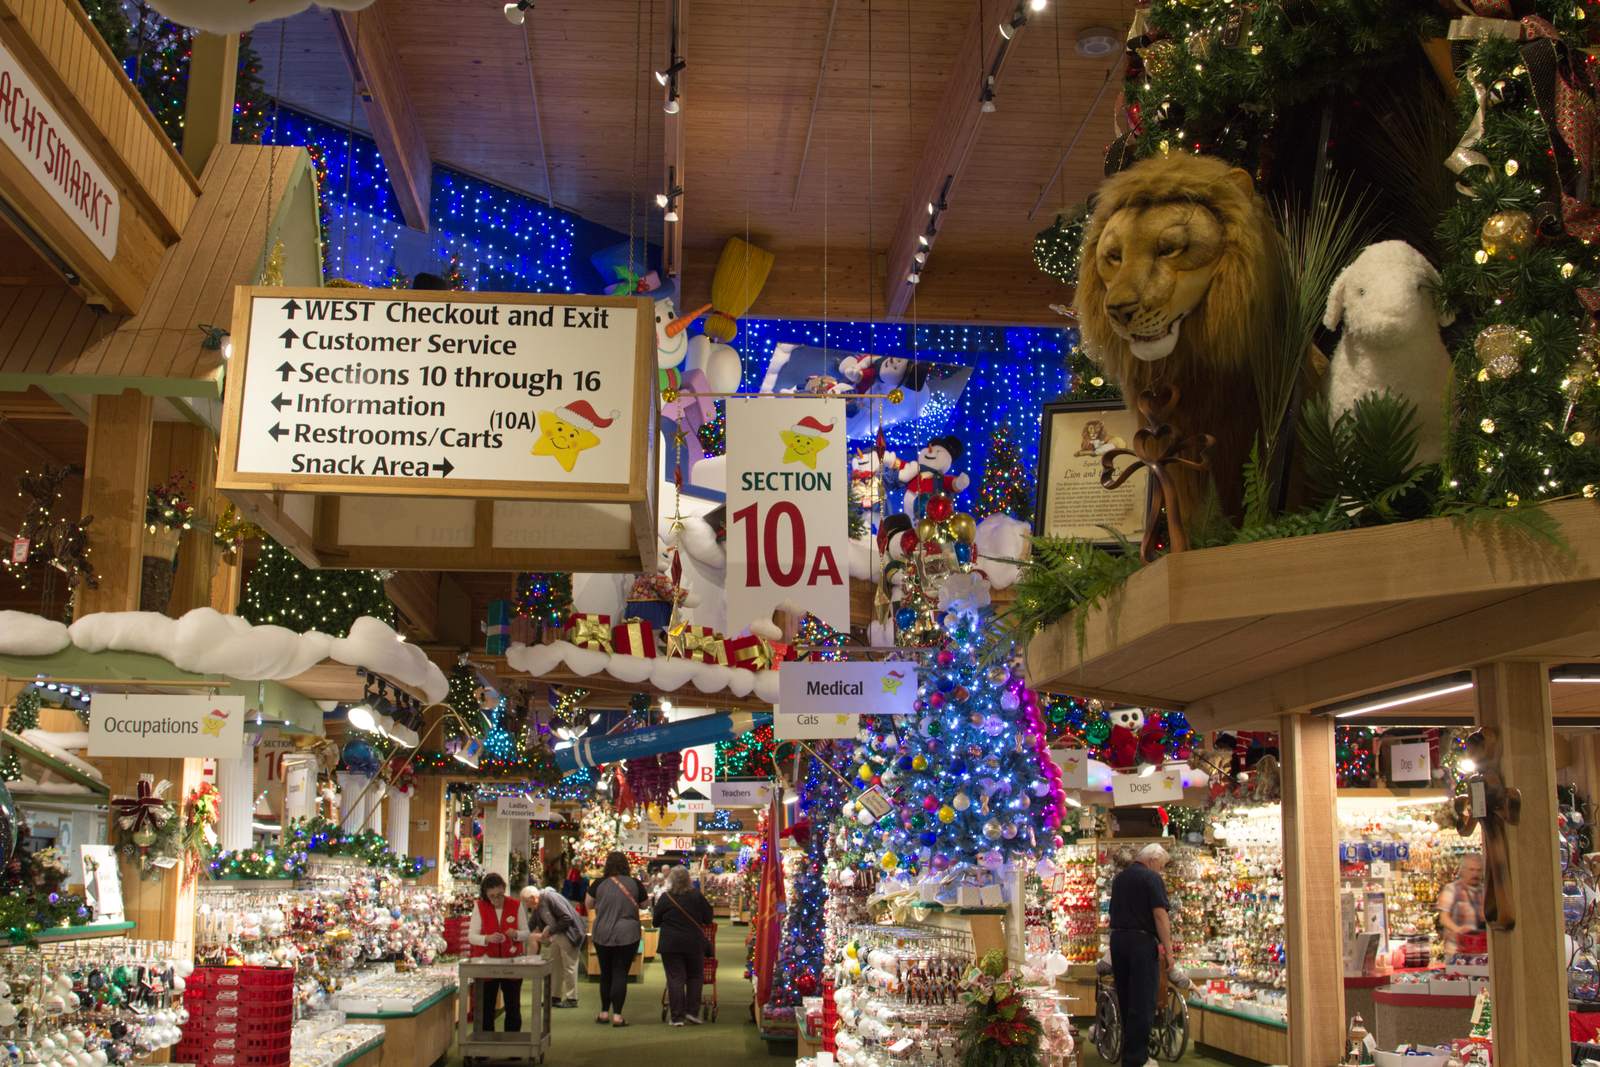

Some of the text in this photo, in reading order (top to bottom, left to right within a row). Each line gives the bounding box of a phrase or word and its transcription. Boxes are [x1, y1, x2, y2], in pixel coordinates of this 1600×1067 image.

[305, 300, 609, 329] WEST Checkout and Exit
[302, 330, 517, 356] Customer Service
[299, 362, 601, 397] Sections 10 through 16
[297, 394, 445, 417] Information
[489, 410, 536, 433] (10A)
[294, 423, 503, 449] Restrooms/Carts
[291, 453, 429, 477] Snack Area
[741, 471, 832, 492] SECTION
[732, 500, 844, 588] 10A
[806, 680, 864, 696] Medical
[103, 716, 199, 738] Occupations
[796, 714, 819, 726] Cats
[721, 789, 751, 798] Teachers
[1129, 783, 1152, 794] Dogs
[501, 809, 535, 817] Accessories
[687, 802, 706, 811] EXIT
